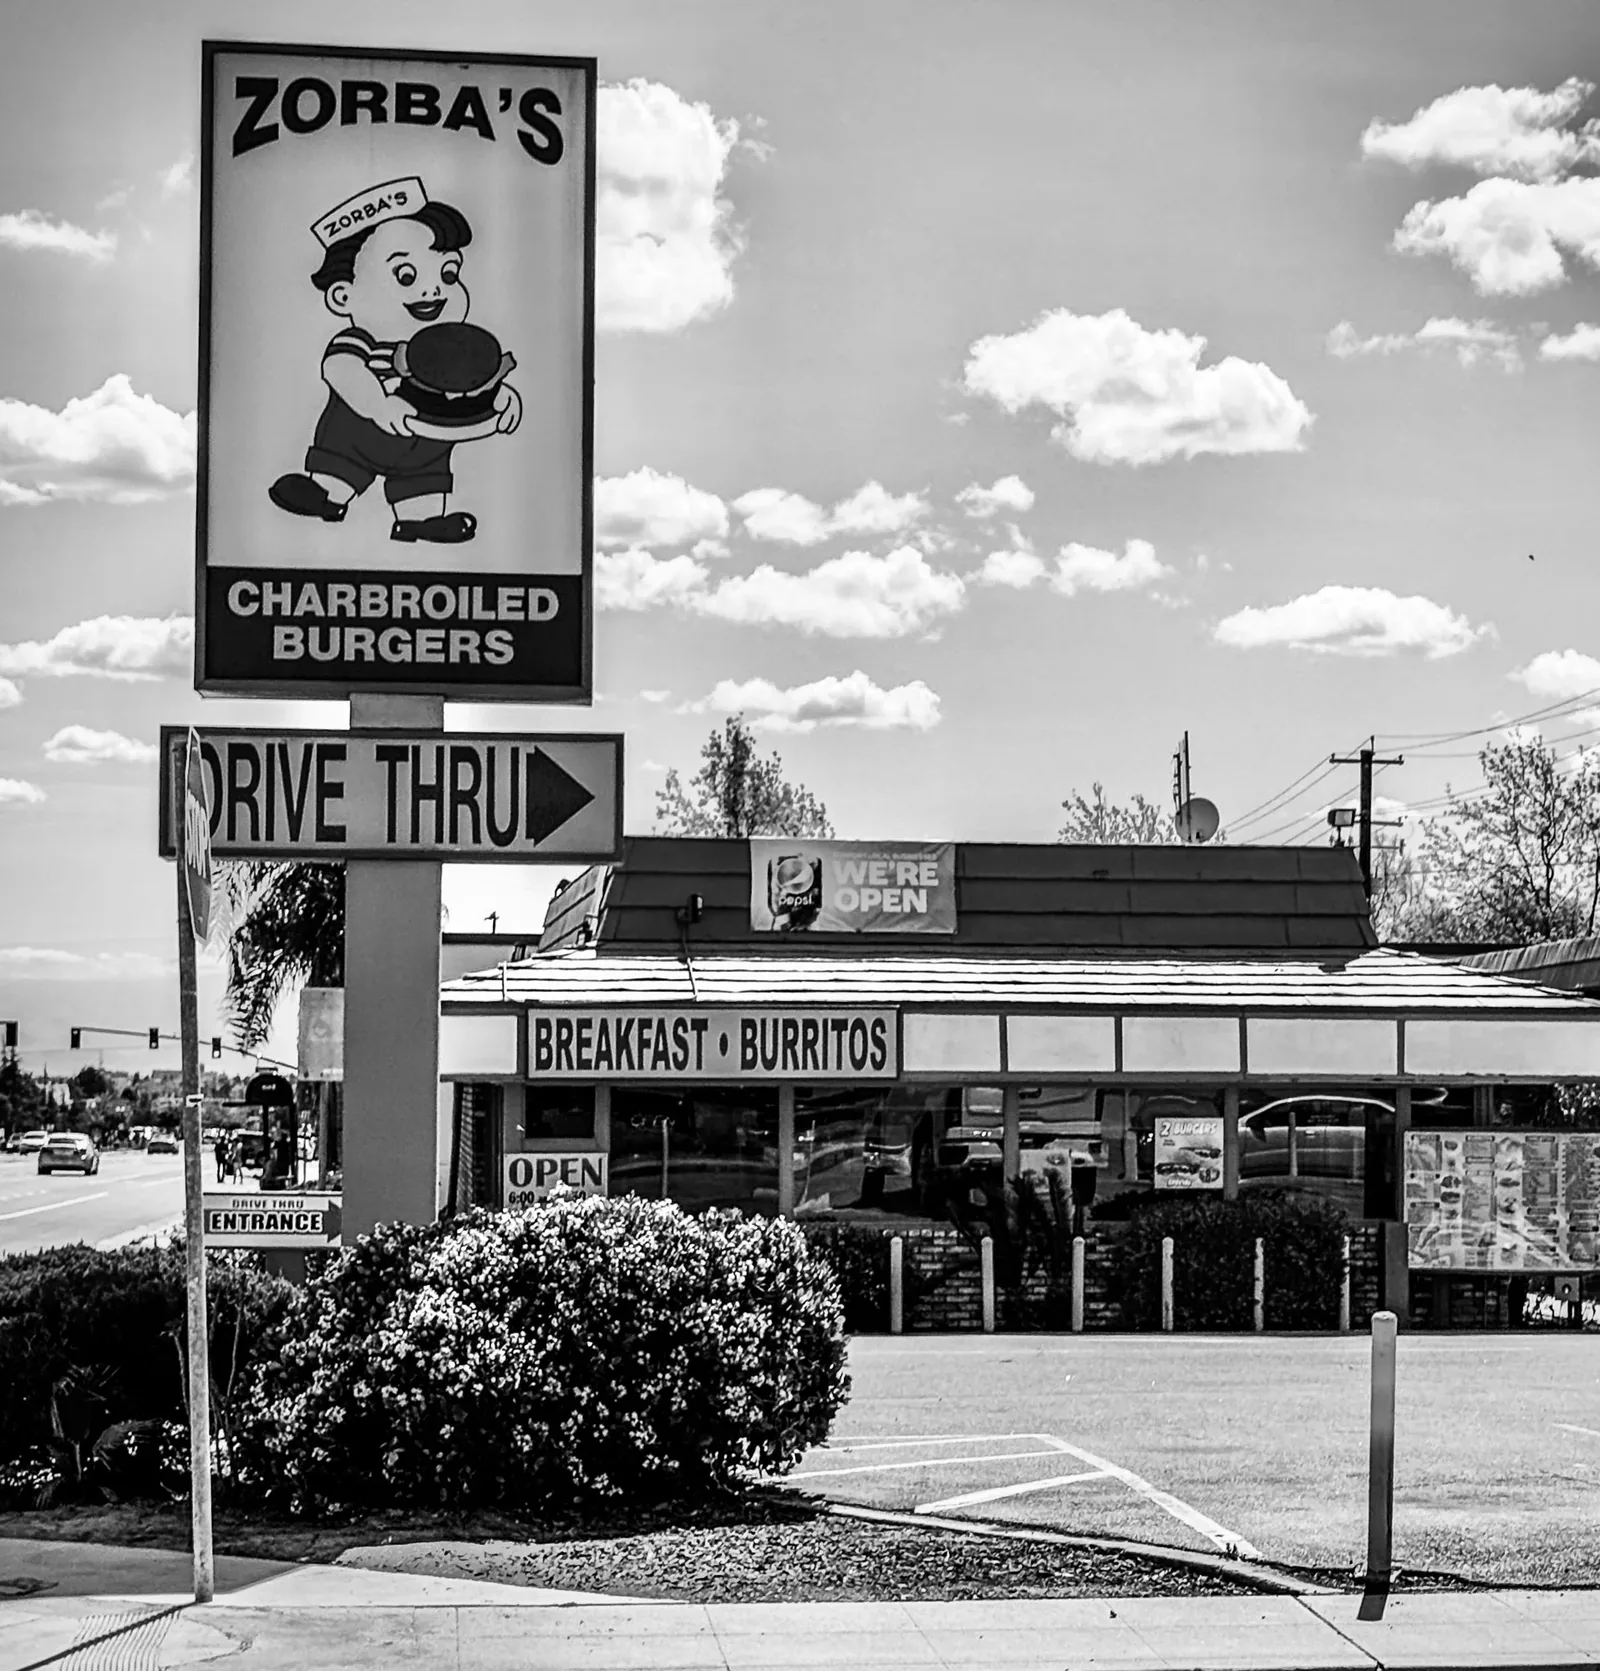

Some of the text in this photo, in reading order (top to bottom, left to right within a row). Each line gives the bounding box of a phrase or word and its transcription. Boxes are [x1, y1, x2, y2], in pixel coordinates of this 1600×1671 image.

[232, 76, 564, 165] ZORBA'S
[323, 191, 408, 238] ZORBA'S
[228, 580, 560, 622] CHARBROILED
[273, 626, 515, 665] BURGERS
[375, 743, 520, 848] THRU
[832, 860, 939, 886] WE'RE
[778, 893, 812, 907] pepsi
[833, 888, 928, 914] OPEN
[535, 1016, 888, 1072] BREAKFAST BURRITOS
[1160, 1120, 1172, 1137] 2
[509, 1157, 603, 1188] OPEN
[232, 1199, 305, 1208] DRIVE THRU
[508, 1190, 535, 1205] 6:00
[210, 1211, 322, 1232] ENTRANCE
